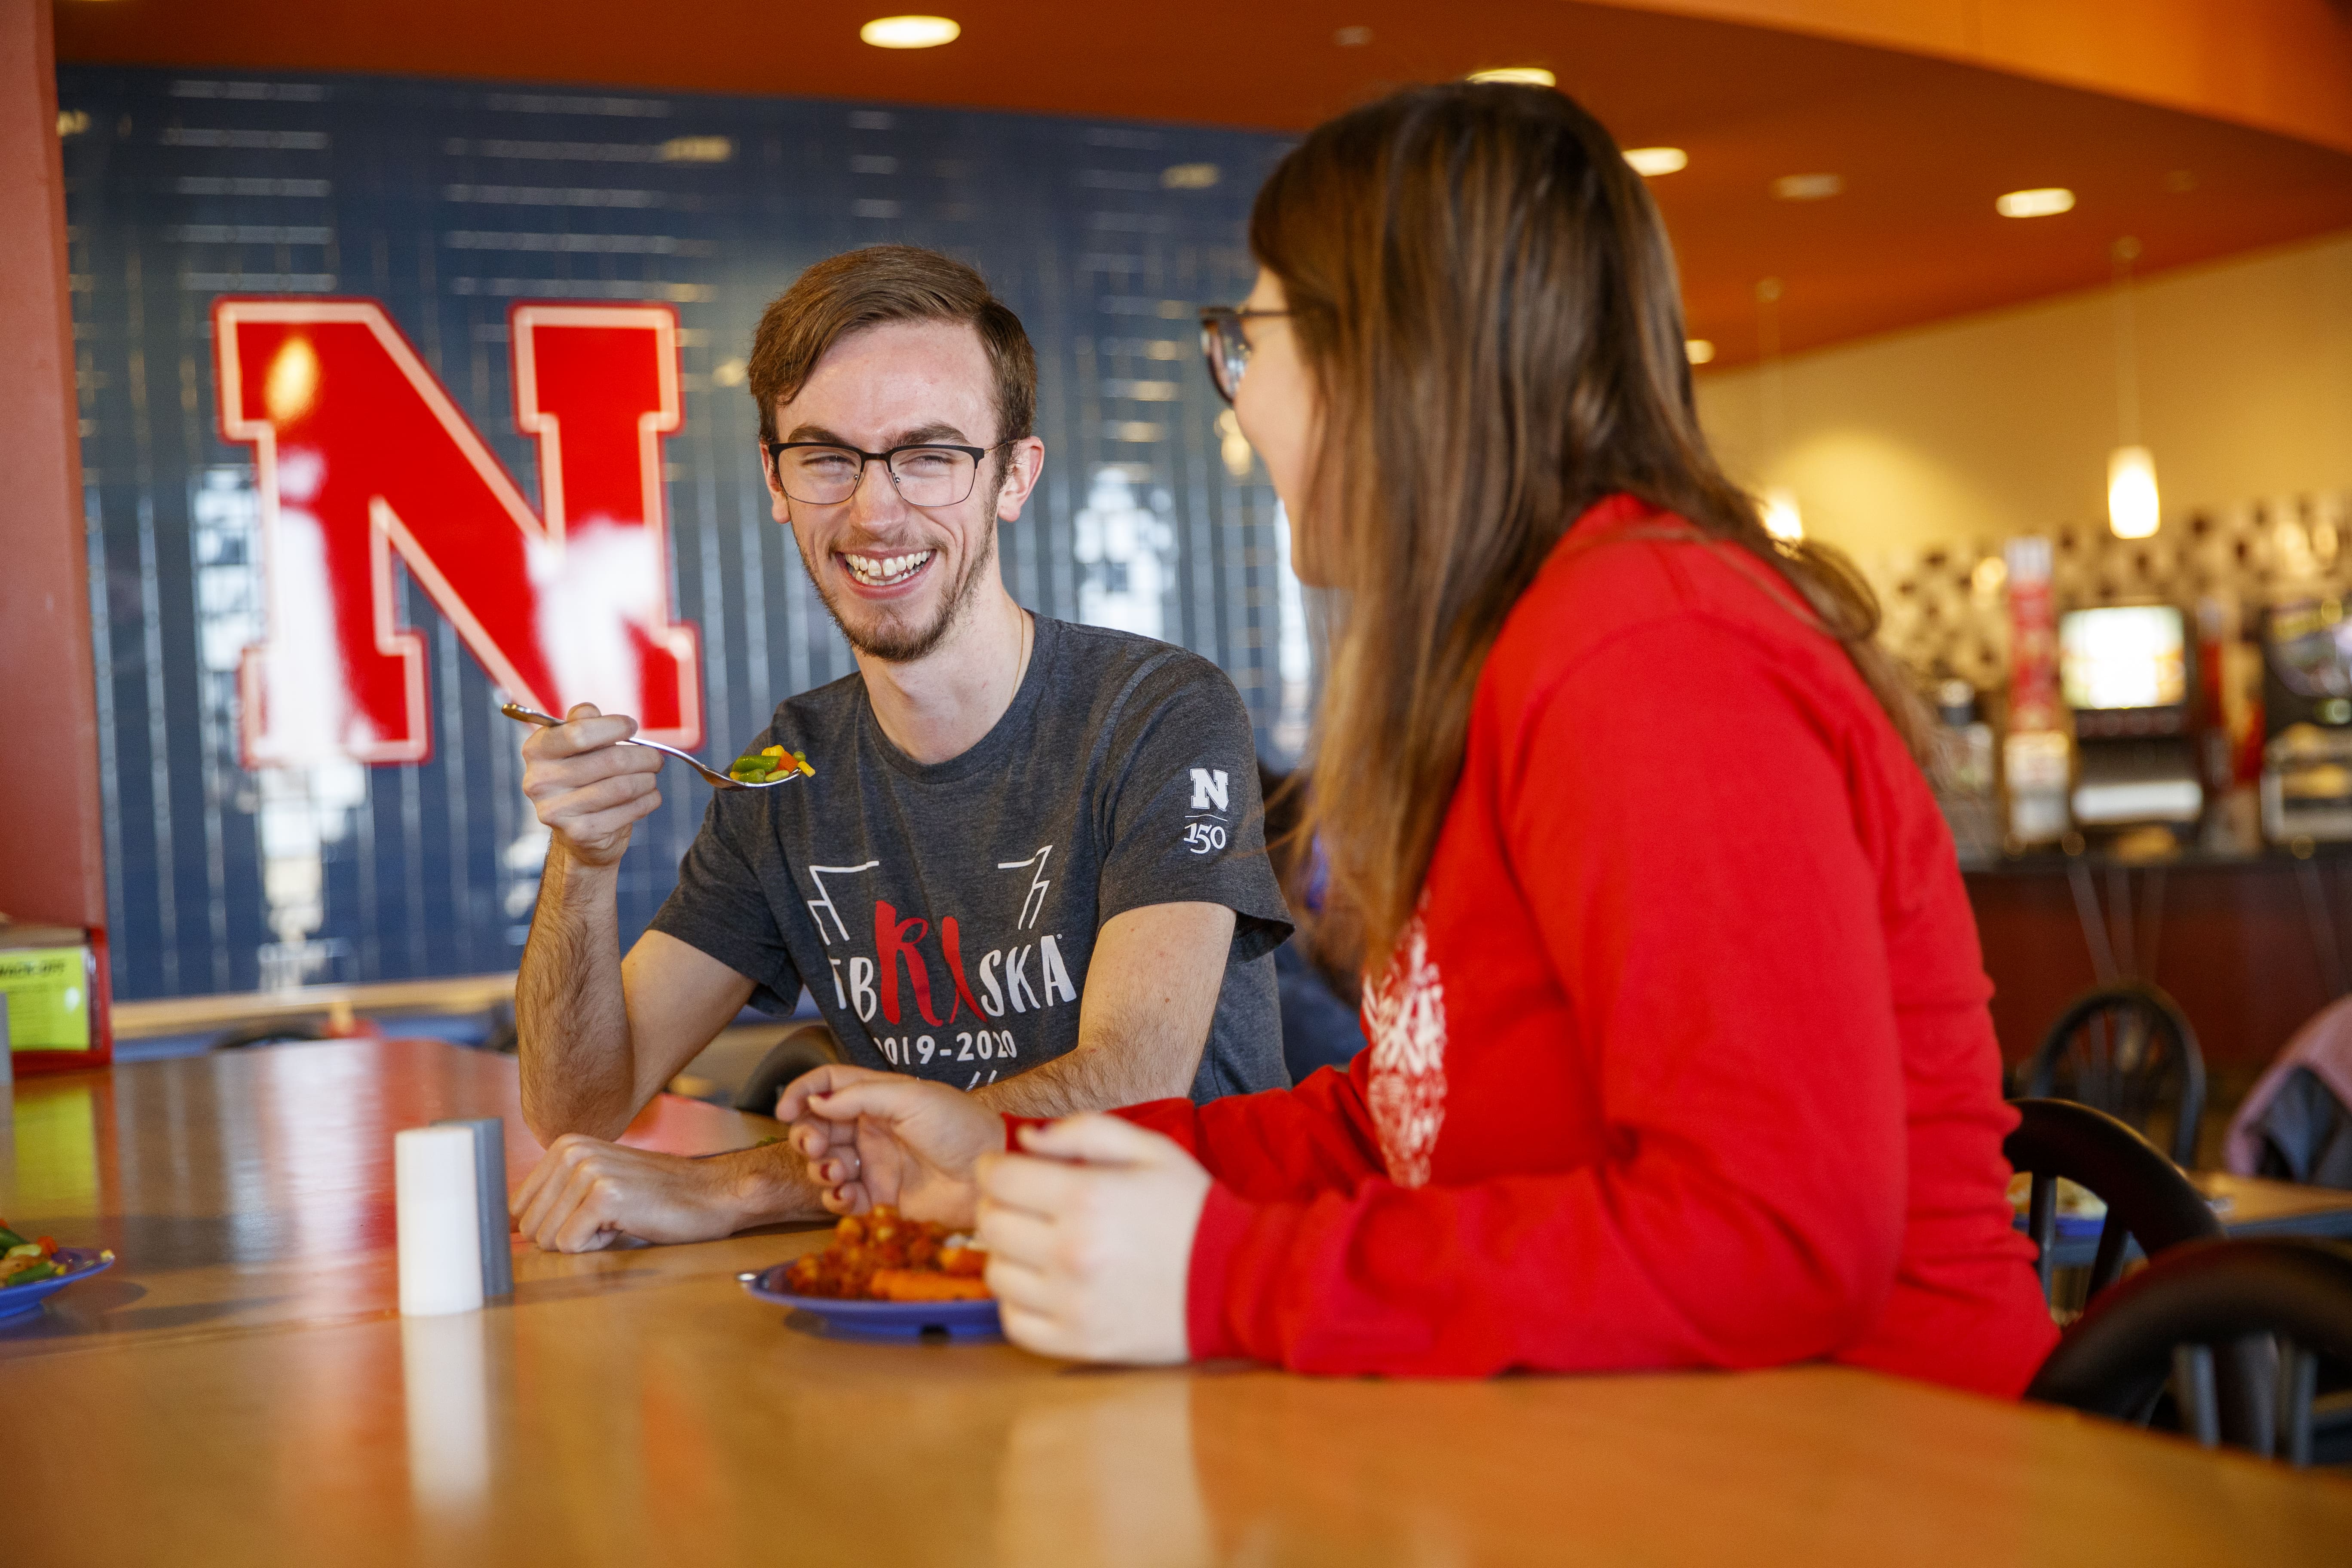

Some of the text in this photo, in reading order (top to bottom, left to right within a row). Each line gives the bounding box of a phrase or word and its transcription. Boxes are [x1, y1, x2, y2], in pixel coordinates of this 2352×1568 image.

[211, 297, 704, 766] N
[1190, 768, 1229, 812] N
[1184, 823, 1226, 854] 150
